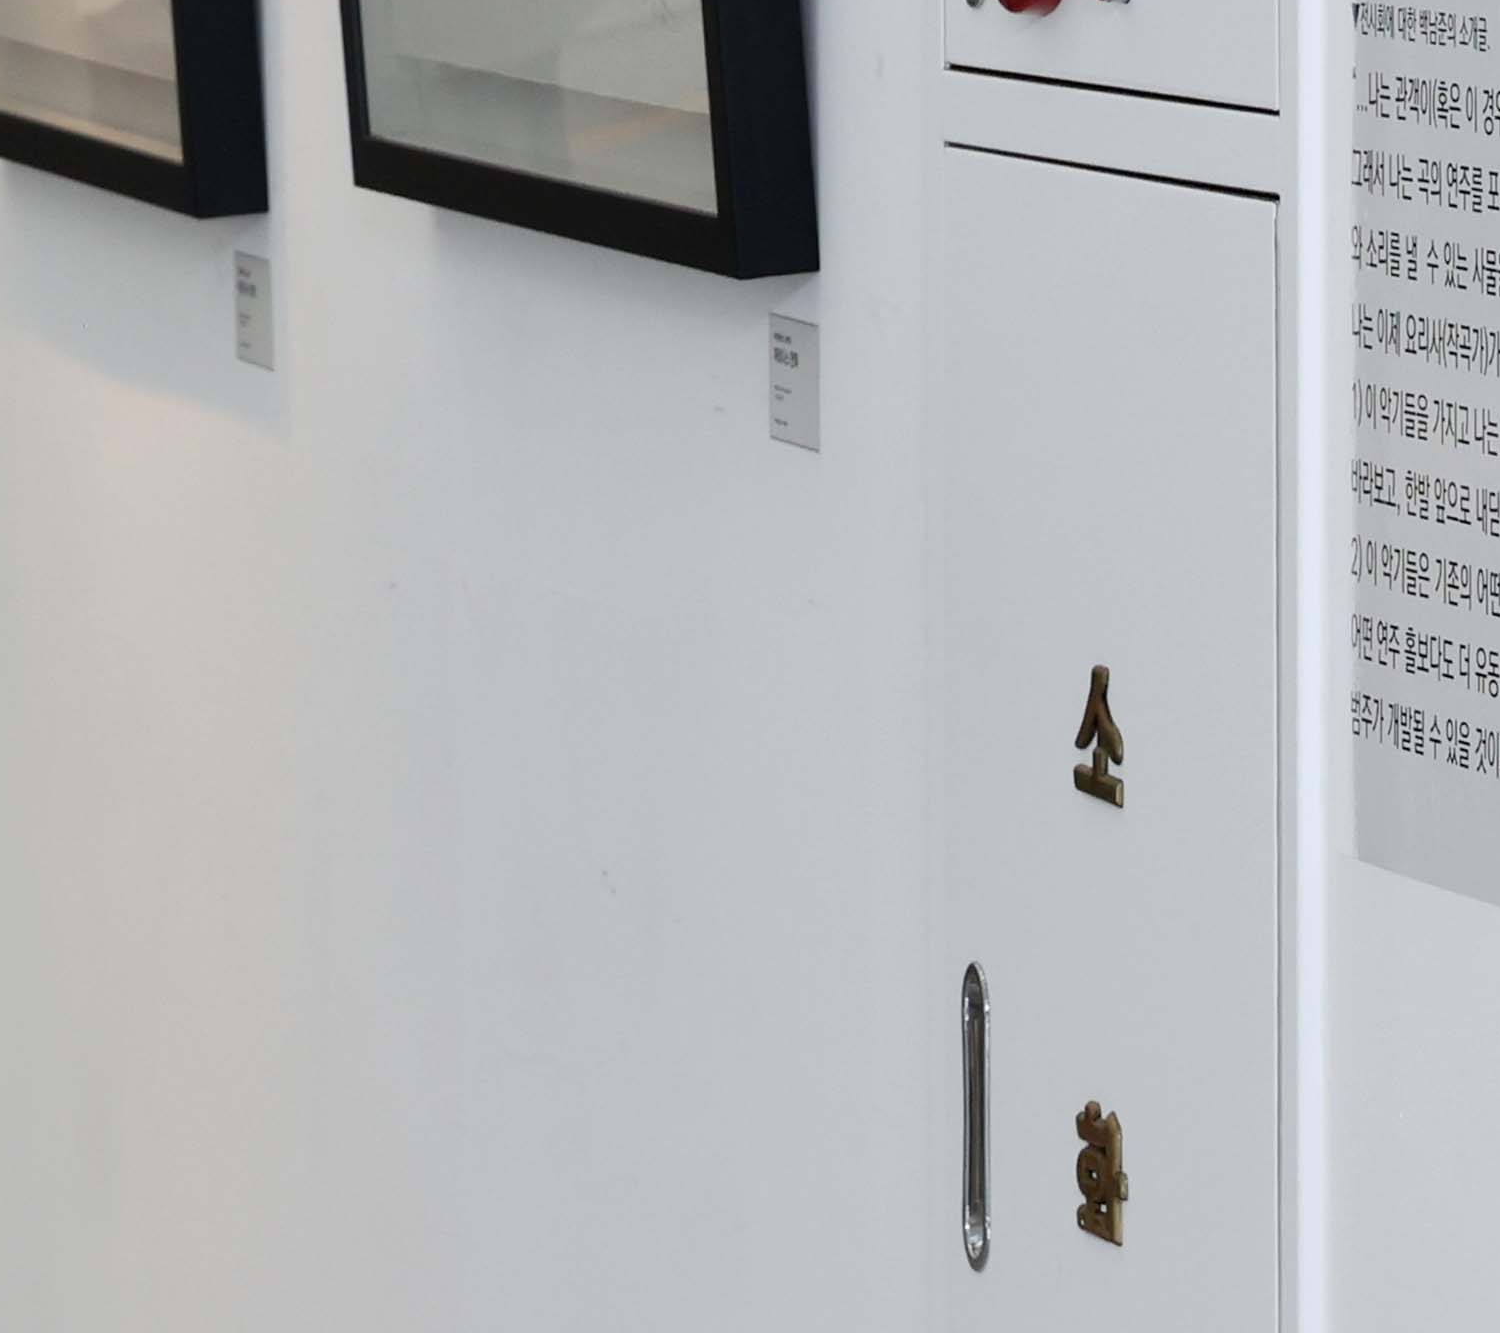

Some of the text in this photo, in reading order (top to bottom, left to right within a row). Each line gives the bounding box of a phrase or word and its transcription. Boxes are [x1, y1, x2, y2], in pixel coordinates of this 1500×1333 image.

[1389, 154, 1414, 201] 나는
[1417, 158, 1442, 206] 곡의
[1446, 162, 1484, 213] 연주를
[1387, 703, 1425, 756] 개발될
[1429, 714, 1442, 759] 수
[1445, 718, 1471, 769] 있을
